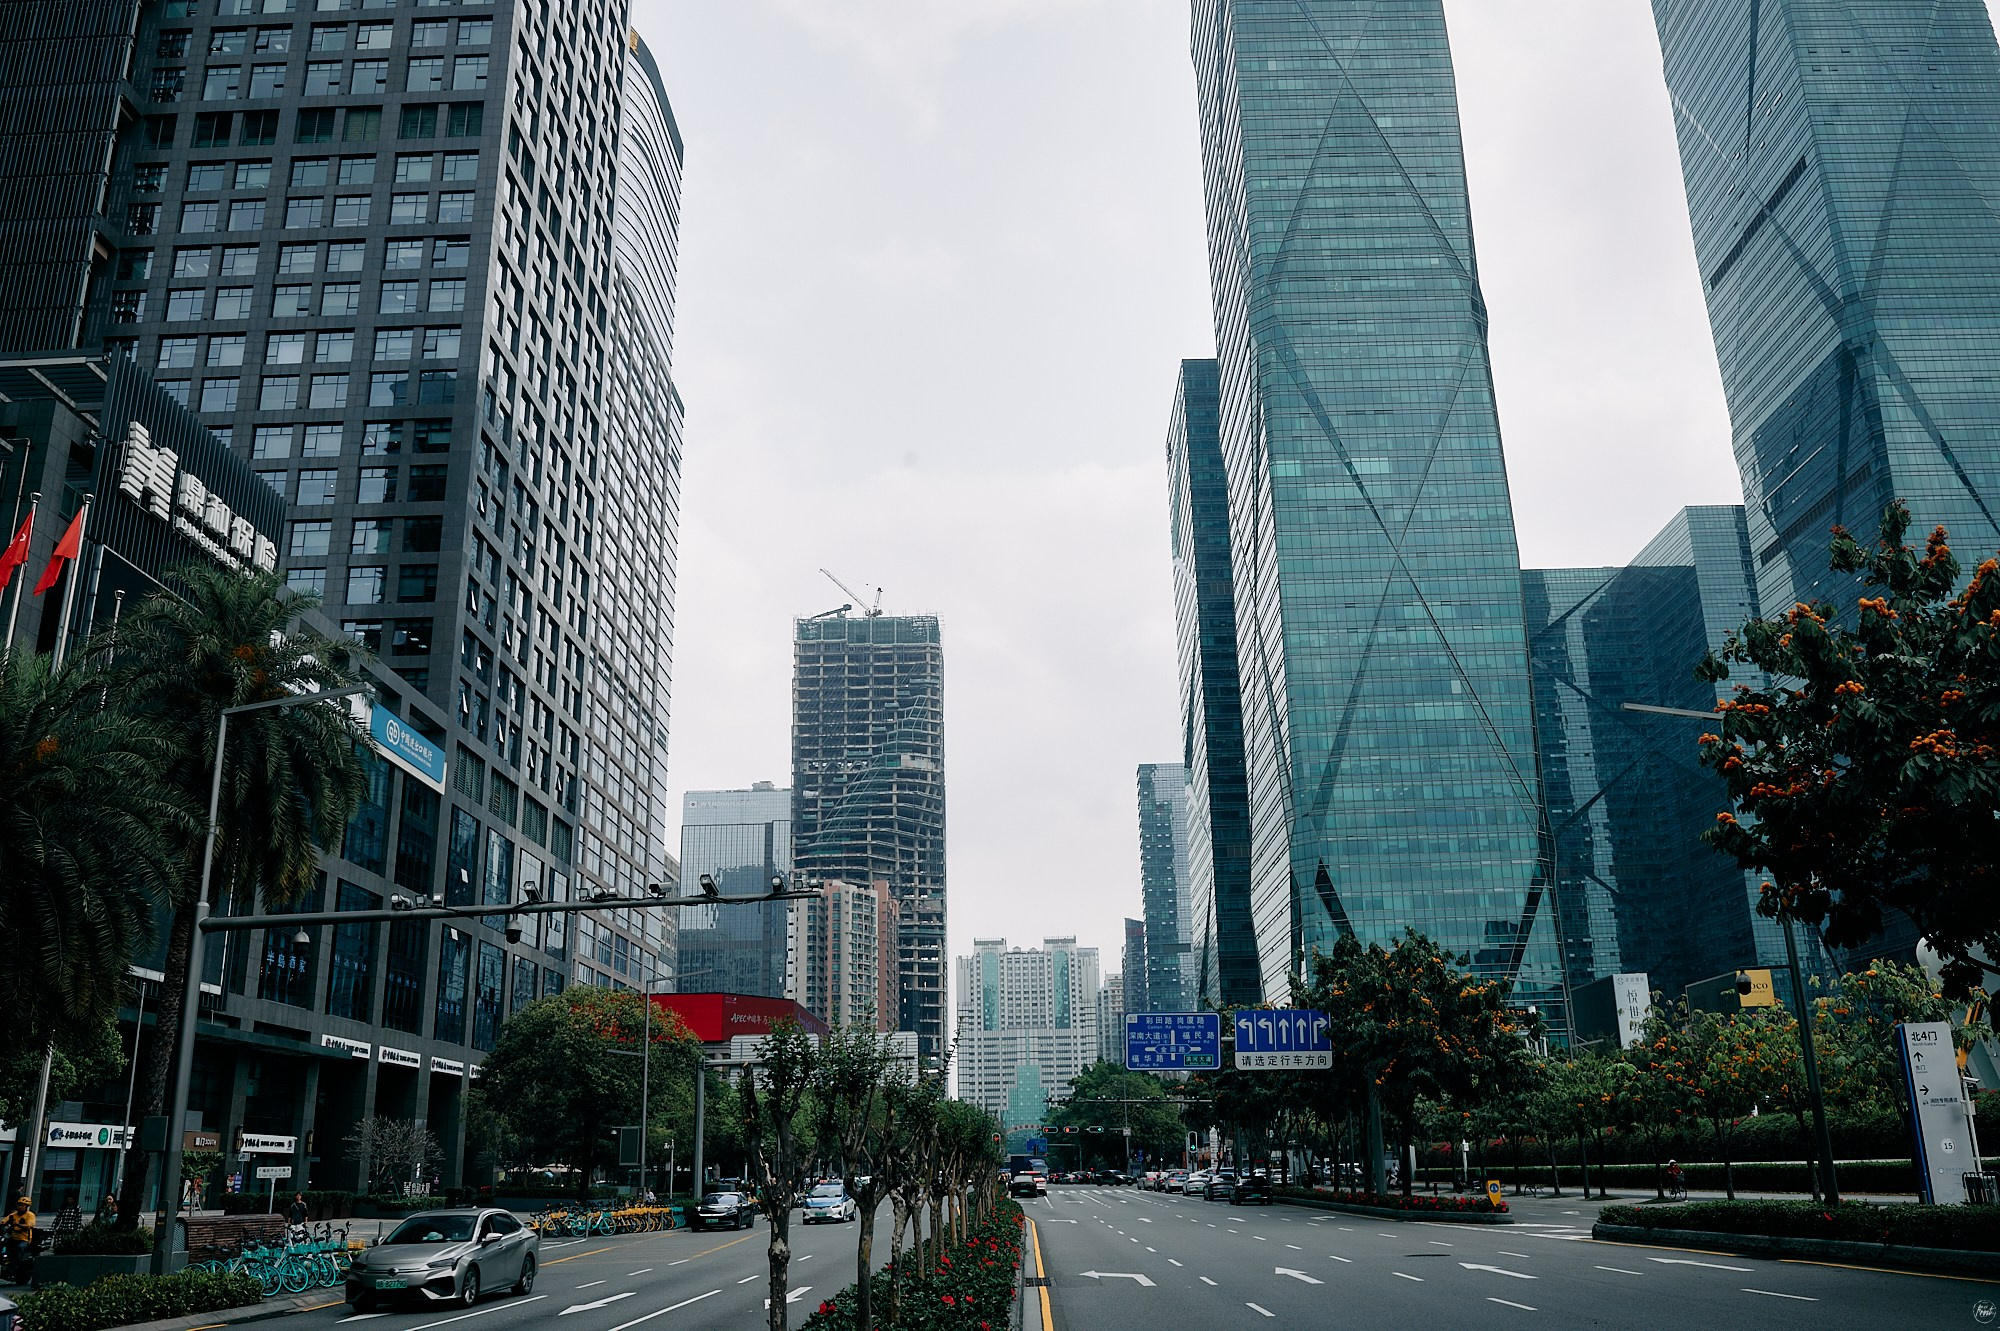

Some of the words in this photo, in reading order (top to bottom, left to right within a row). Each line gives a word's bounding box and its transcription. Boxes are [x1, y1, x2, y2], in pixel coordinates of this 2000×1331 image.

[179, 473, 277, 574] 鼎和保险
[1146, 1016, 1172, 1025] 彩田路
[1177, 1016, 1205, 1025] 岗厦路
[1182, 1031, 1215, 1040] 福民路
[1911, 1031, 1938, 1041] 北4门
[1132, 1054, 1164, 1063] 福华路
[1241, 1054, 1327, 1067] 请选定行车方向
[1944, 1142, 1953, 1150] 15
